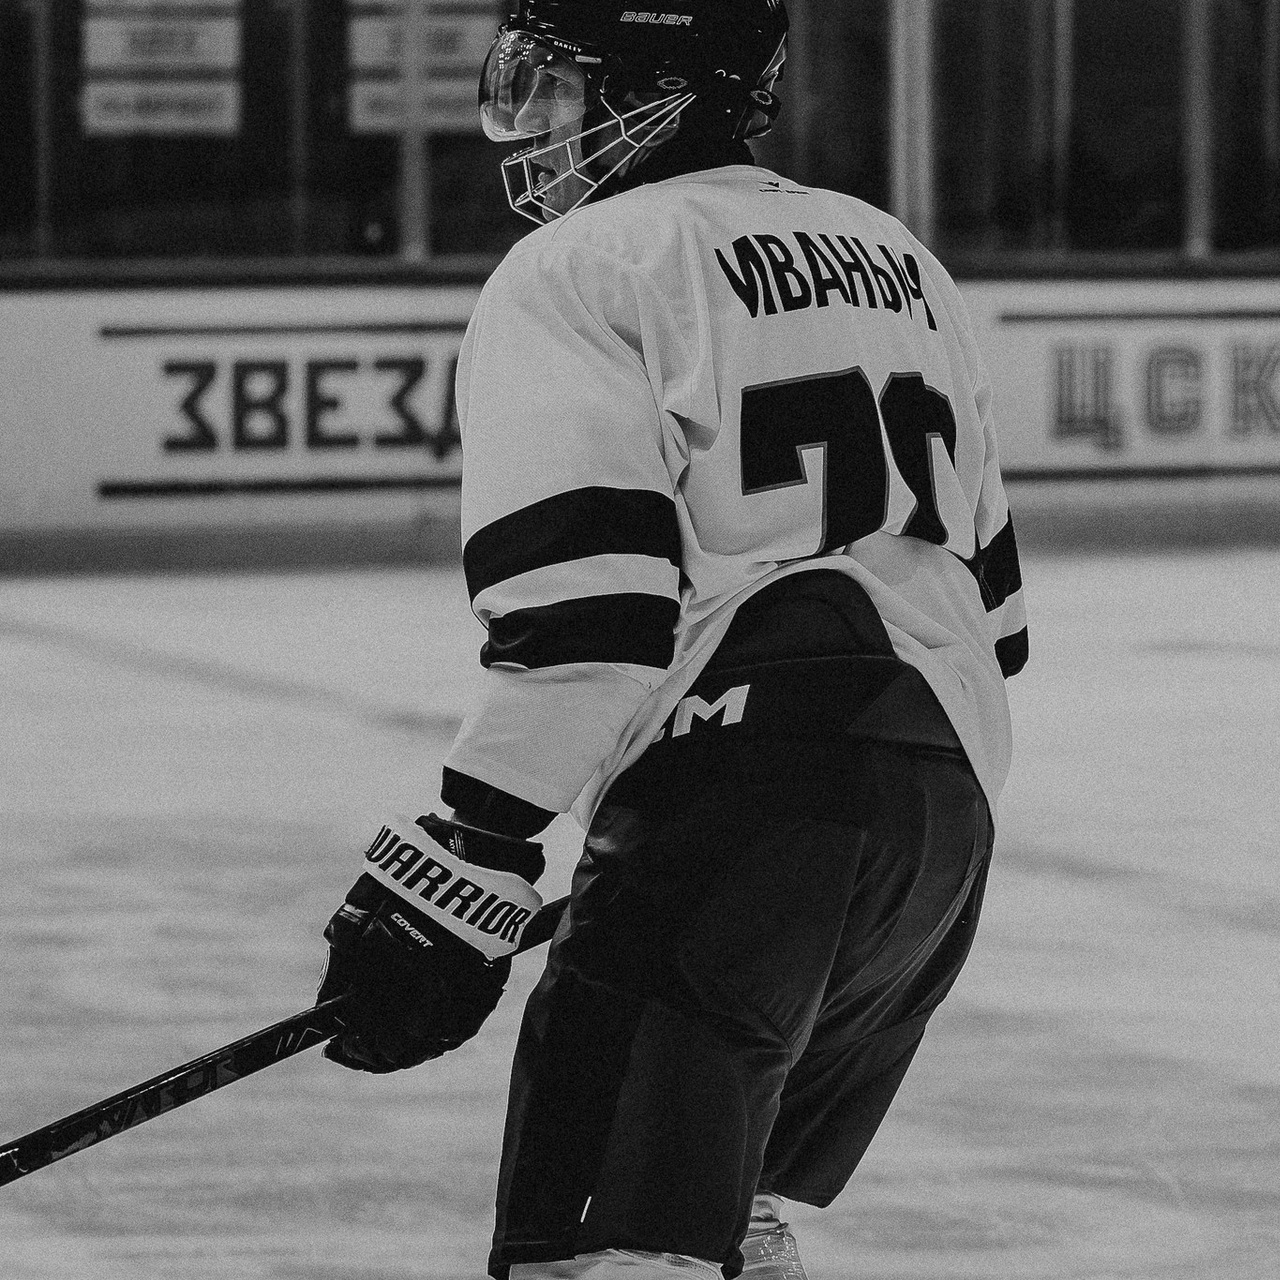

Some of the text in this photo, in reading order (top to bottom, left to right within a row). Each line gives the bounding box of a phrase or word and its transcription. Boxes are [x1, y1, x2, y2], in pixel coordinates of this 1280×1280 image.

[620, 11, 693, 26] BAUER
[651, 684, 751, 744] M
[363, 824, 532, 944] WARRIOR
[390, 912, 434, 948] COVERT
